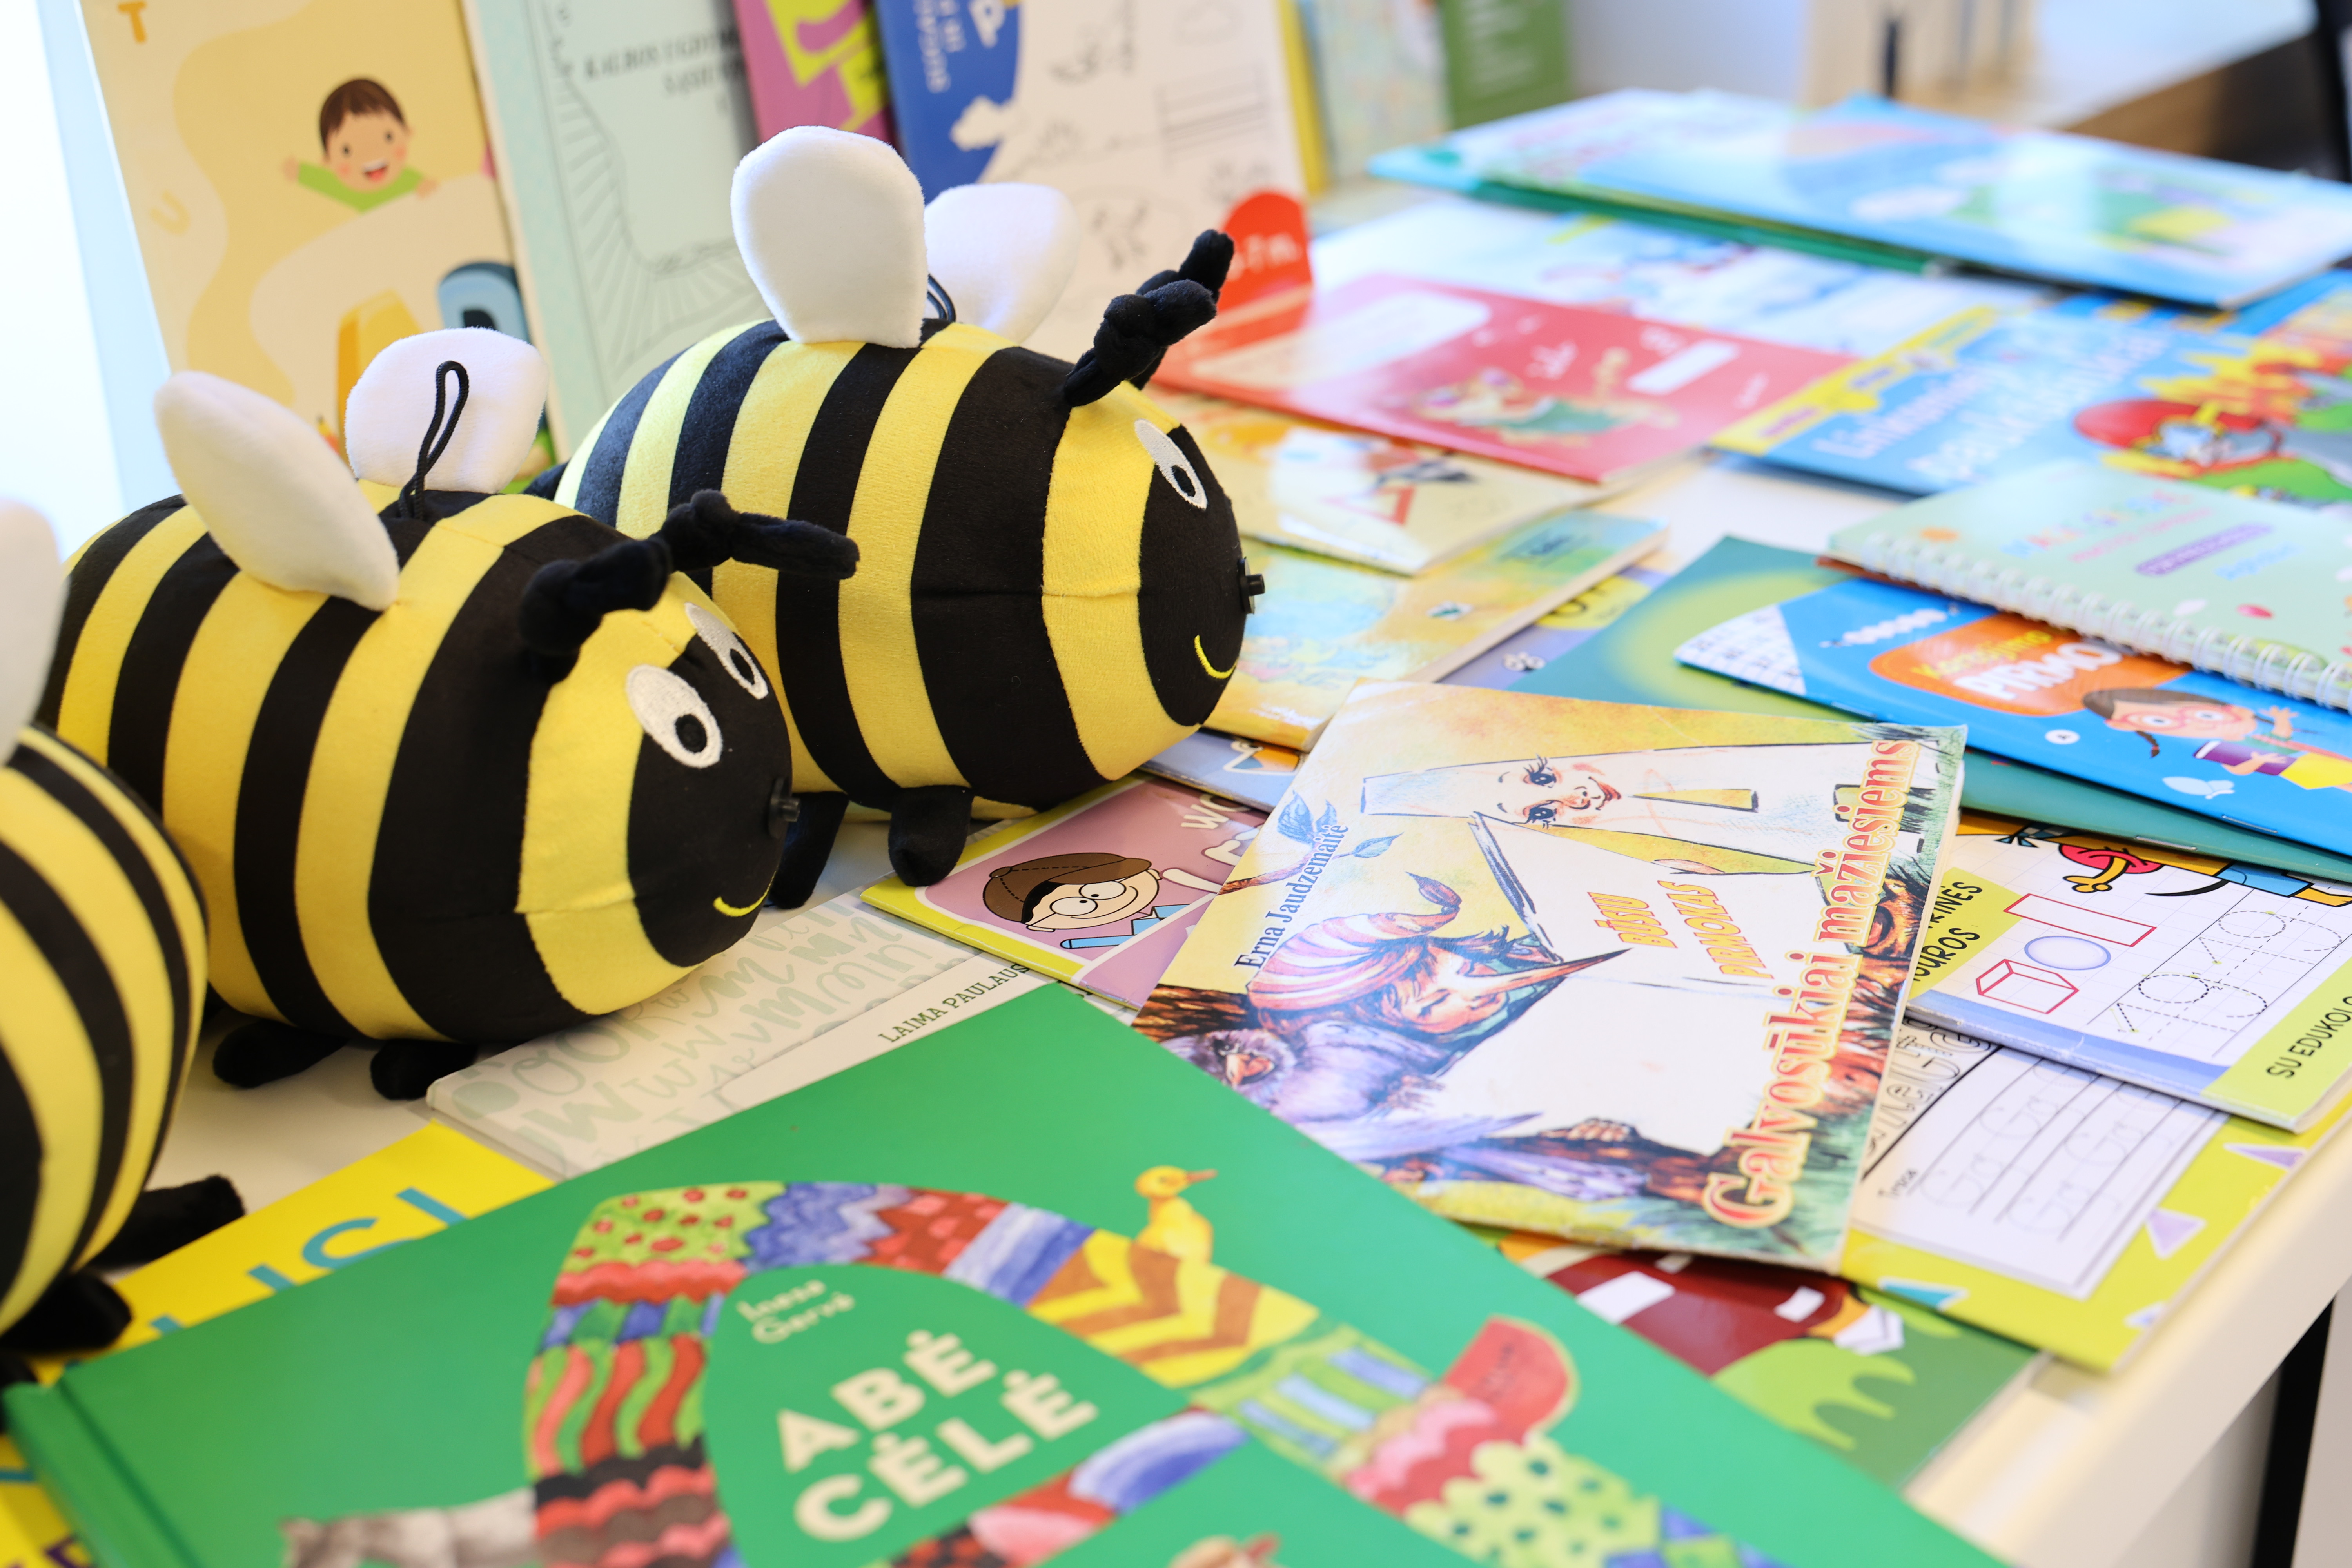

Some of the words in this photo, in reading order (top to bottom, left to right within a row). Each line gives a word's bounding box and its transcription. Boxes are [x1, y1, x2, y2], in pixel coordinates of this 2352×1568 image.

[1234, 918, 1286, 970] Erna
[1266, 825, 1349, 923] Jaudzemaitė
[1588, 891, 1677, 949] BŪSIU
[1657, 880, 1775, 980] PIRMOKAS
[878, 1007, 949, 1043] LAIMA
[1702, 950, 1864, 1229] Galvosūkiai
[1810, 739, 1921, 948] mažiesiems
[2266, 1056, 2302, 1079] SU
[776, 1329, 998, 1474] ABĖ
[792, 1368, 1100, 1543] CĖLĖ
